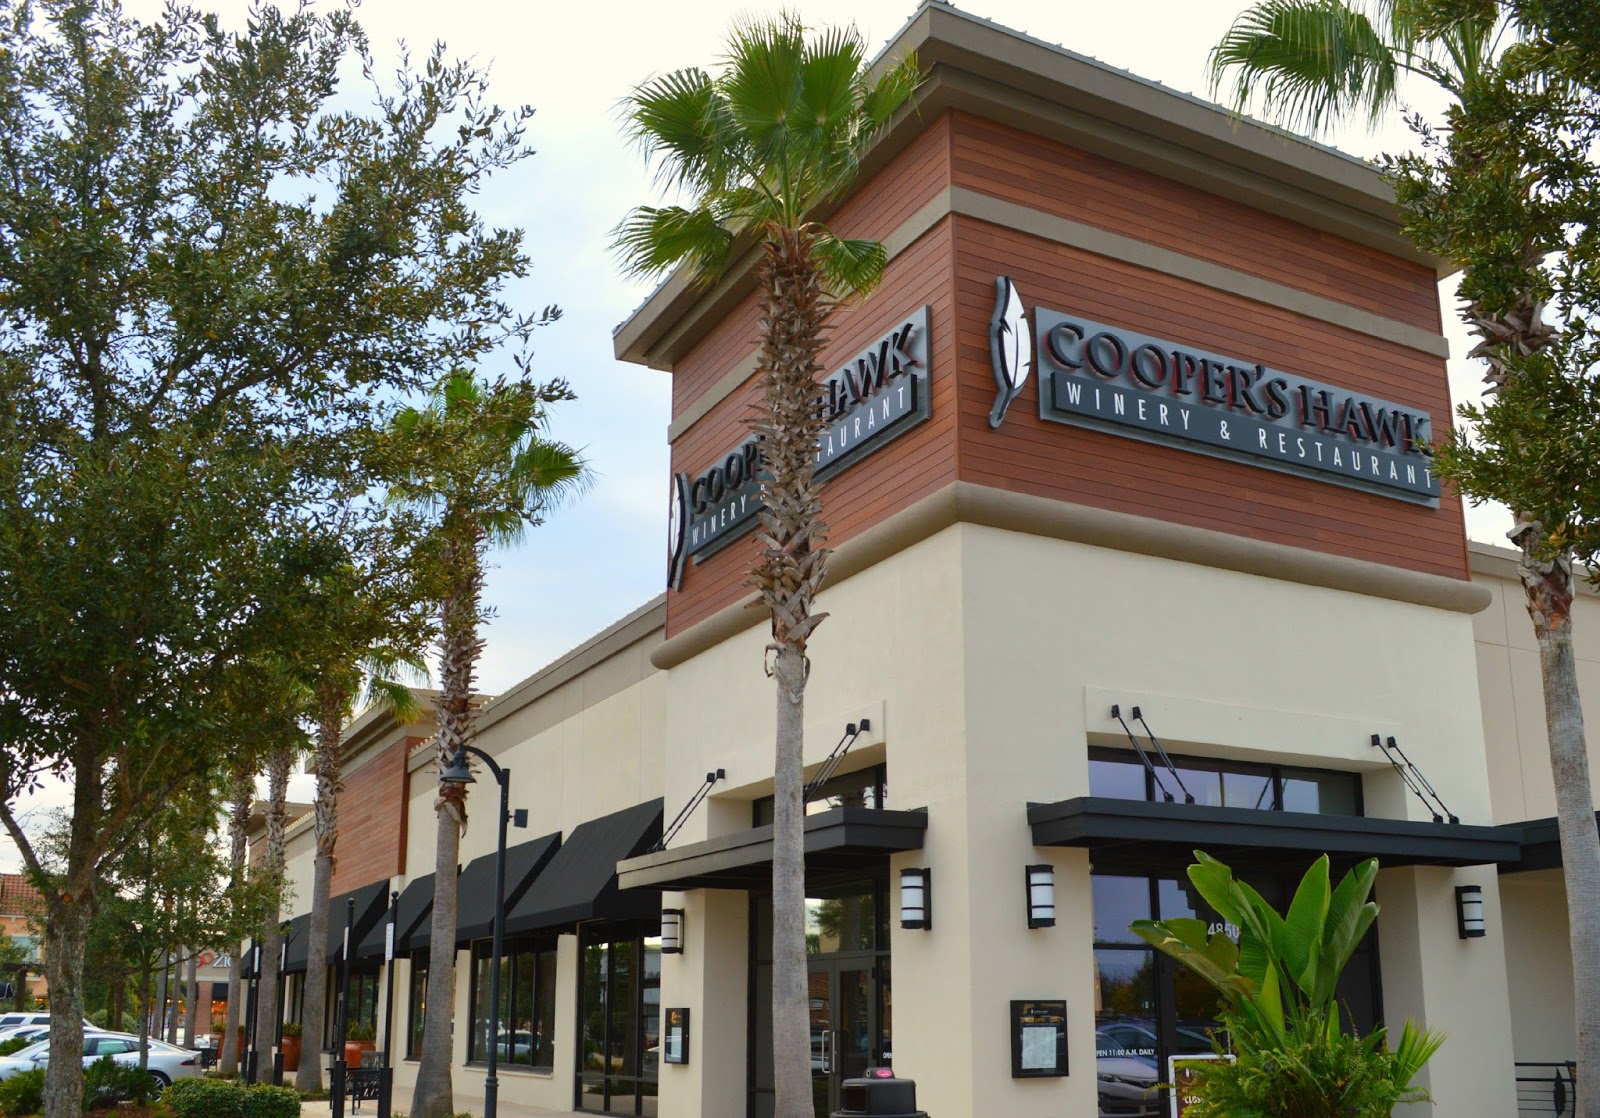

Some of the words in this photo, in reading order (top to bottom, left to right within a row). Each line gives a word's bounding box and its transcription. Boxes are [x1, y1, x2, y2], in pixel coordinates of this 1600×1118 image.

[1049, 322, 1292, 419] COOPER'S
[1297, 385, 1434, 458] HAWK
[1066, 381, 1190, 431] WINERY
[1220, 420, 1231, 441] &
[1258, 427, 1432, 489] RESTAURANT
[691, 440, 764, 515] COOP
[692, 494, 747, 546] WINERY
[816, 386, 904, 462] TAURANT
[1207, 922, 1240, 939] 4850
